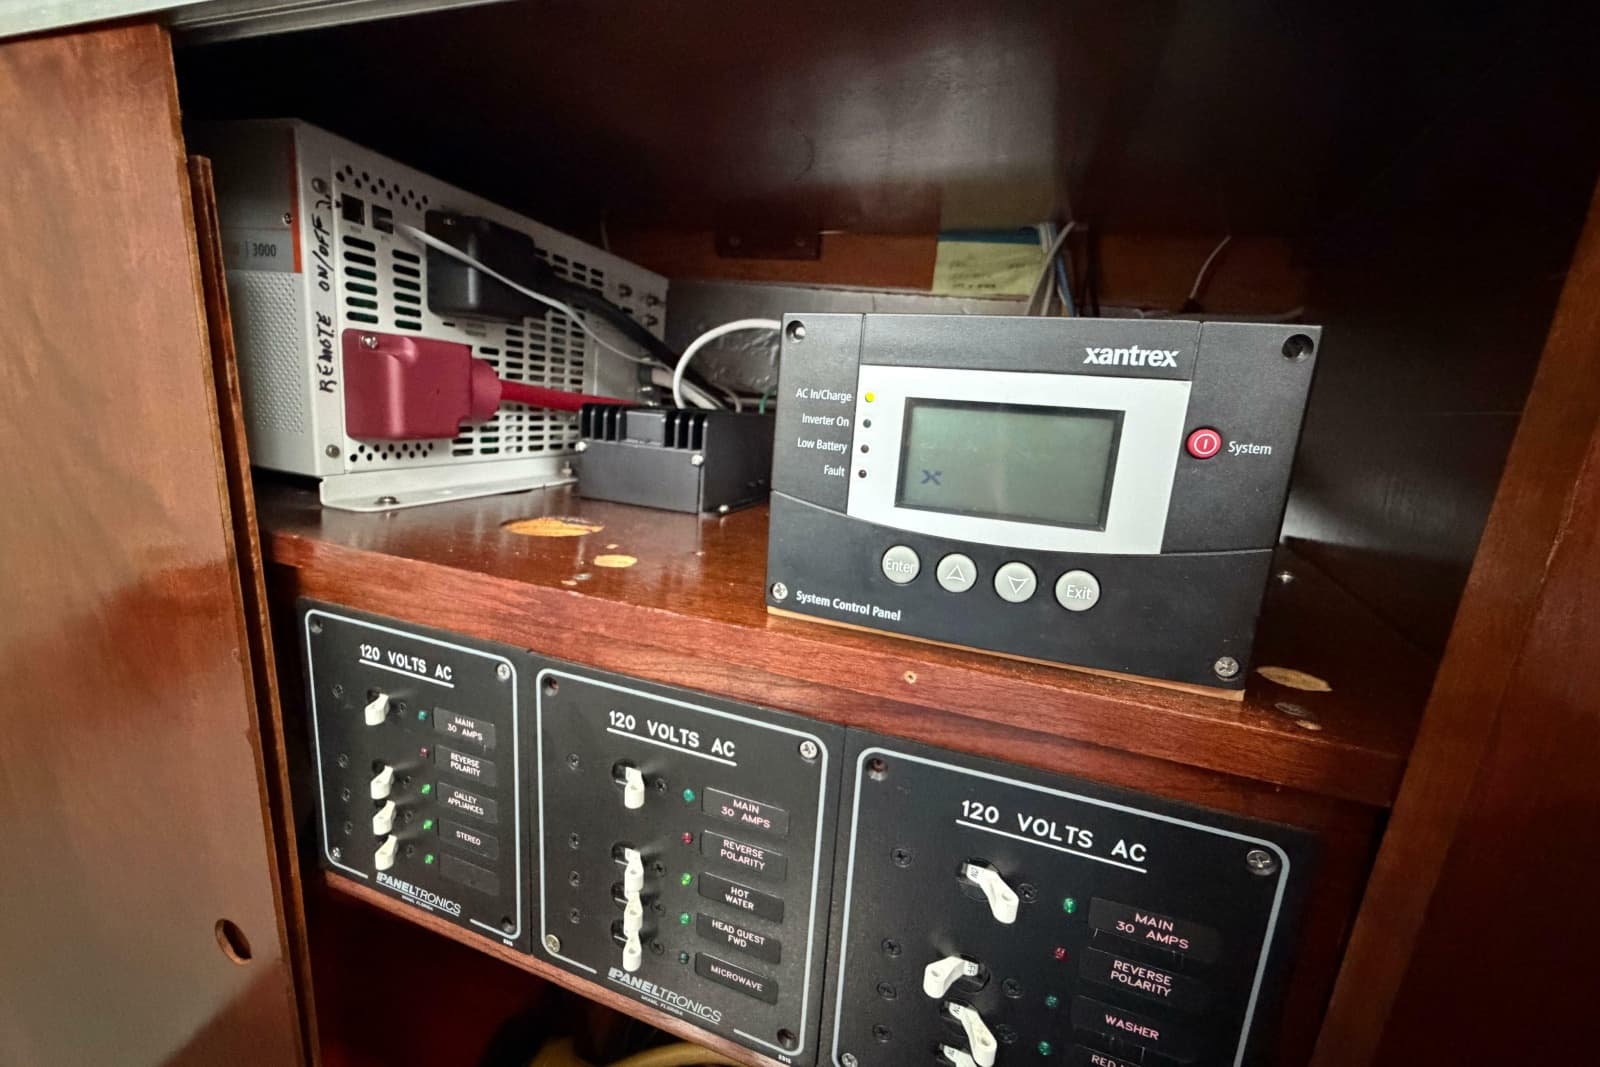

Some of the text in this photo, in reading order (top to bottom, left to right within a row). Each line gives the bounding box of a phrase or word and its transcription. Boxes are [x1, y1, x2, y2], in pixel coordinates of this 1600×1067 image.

[252, 243, 277, 257] 3000
[311, 212, 337, 393] REMOTE ON/OFF
[1083, 345, 1180, 367] xantrex
[795, 387, 852, 404] AC In/Charge
[802, 412, 849, 427] Inverter On
[797, 437, 847, 454] Low Battery
[1228, 440, 1272, 456] System
[823, 464, 845, 477] Fault
[886, 557, 915, 575] Enter
[1066, 584, 1093, 600] Exit
[796, 590, 901, 621] System Control Panel
[360, 643, 453, 680] 120 VOLTS AC
[447, 723, 483, 741] 30 AMPS
[454, 717, 475, 729] MAIN
[609, 710, 735, 757] 120 VOLTS AC
[450, 752, 480, 769] REVERSE
[450, 760, 481, 777] POLARITY
[447, 797, 485, 816] APPLIANCES
[733, 799, 760, 814] MAIN
[721, 806, 771, 829] 30 AMPS
[455, 830, 481, 846] STEREO
[962, 800, 1147, 862] 120 VOLTS AC
[723, 839, 765, 860] REVERSE
[720, 849, 766, 871] POLARITY
[730, 886, 749, 899] HOT
[725, 894, 754, 911] WATER
[1135, 912, 1174, 932] MAIN
[711, 919, 765, 946] HEAD GUEST
[727, 935, 747, 948] FWD
[1115, 920, 1190, 949] 30 AMPS
[710, 964, 763, 992] MICROWAVE
[1113, 960, 1173, 986] REVERSE
[1110, 970, 1172, 997] POLARITY
[1104, 1013, 1160, 1040] WASHER
[1091, 1054, 1117, 1067] RED
